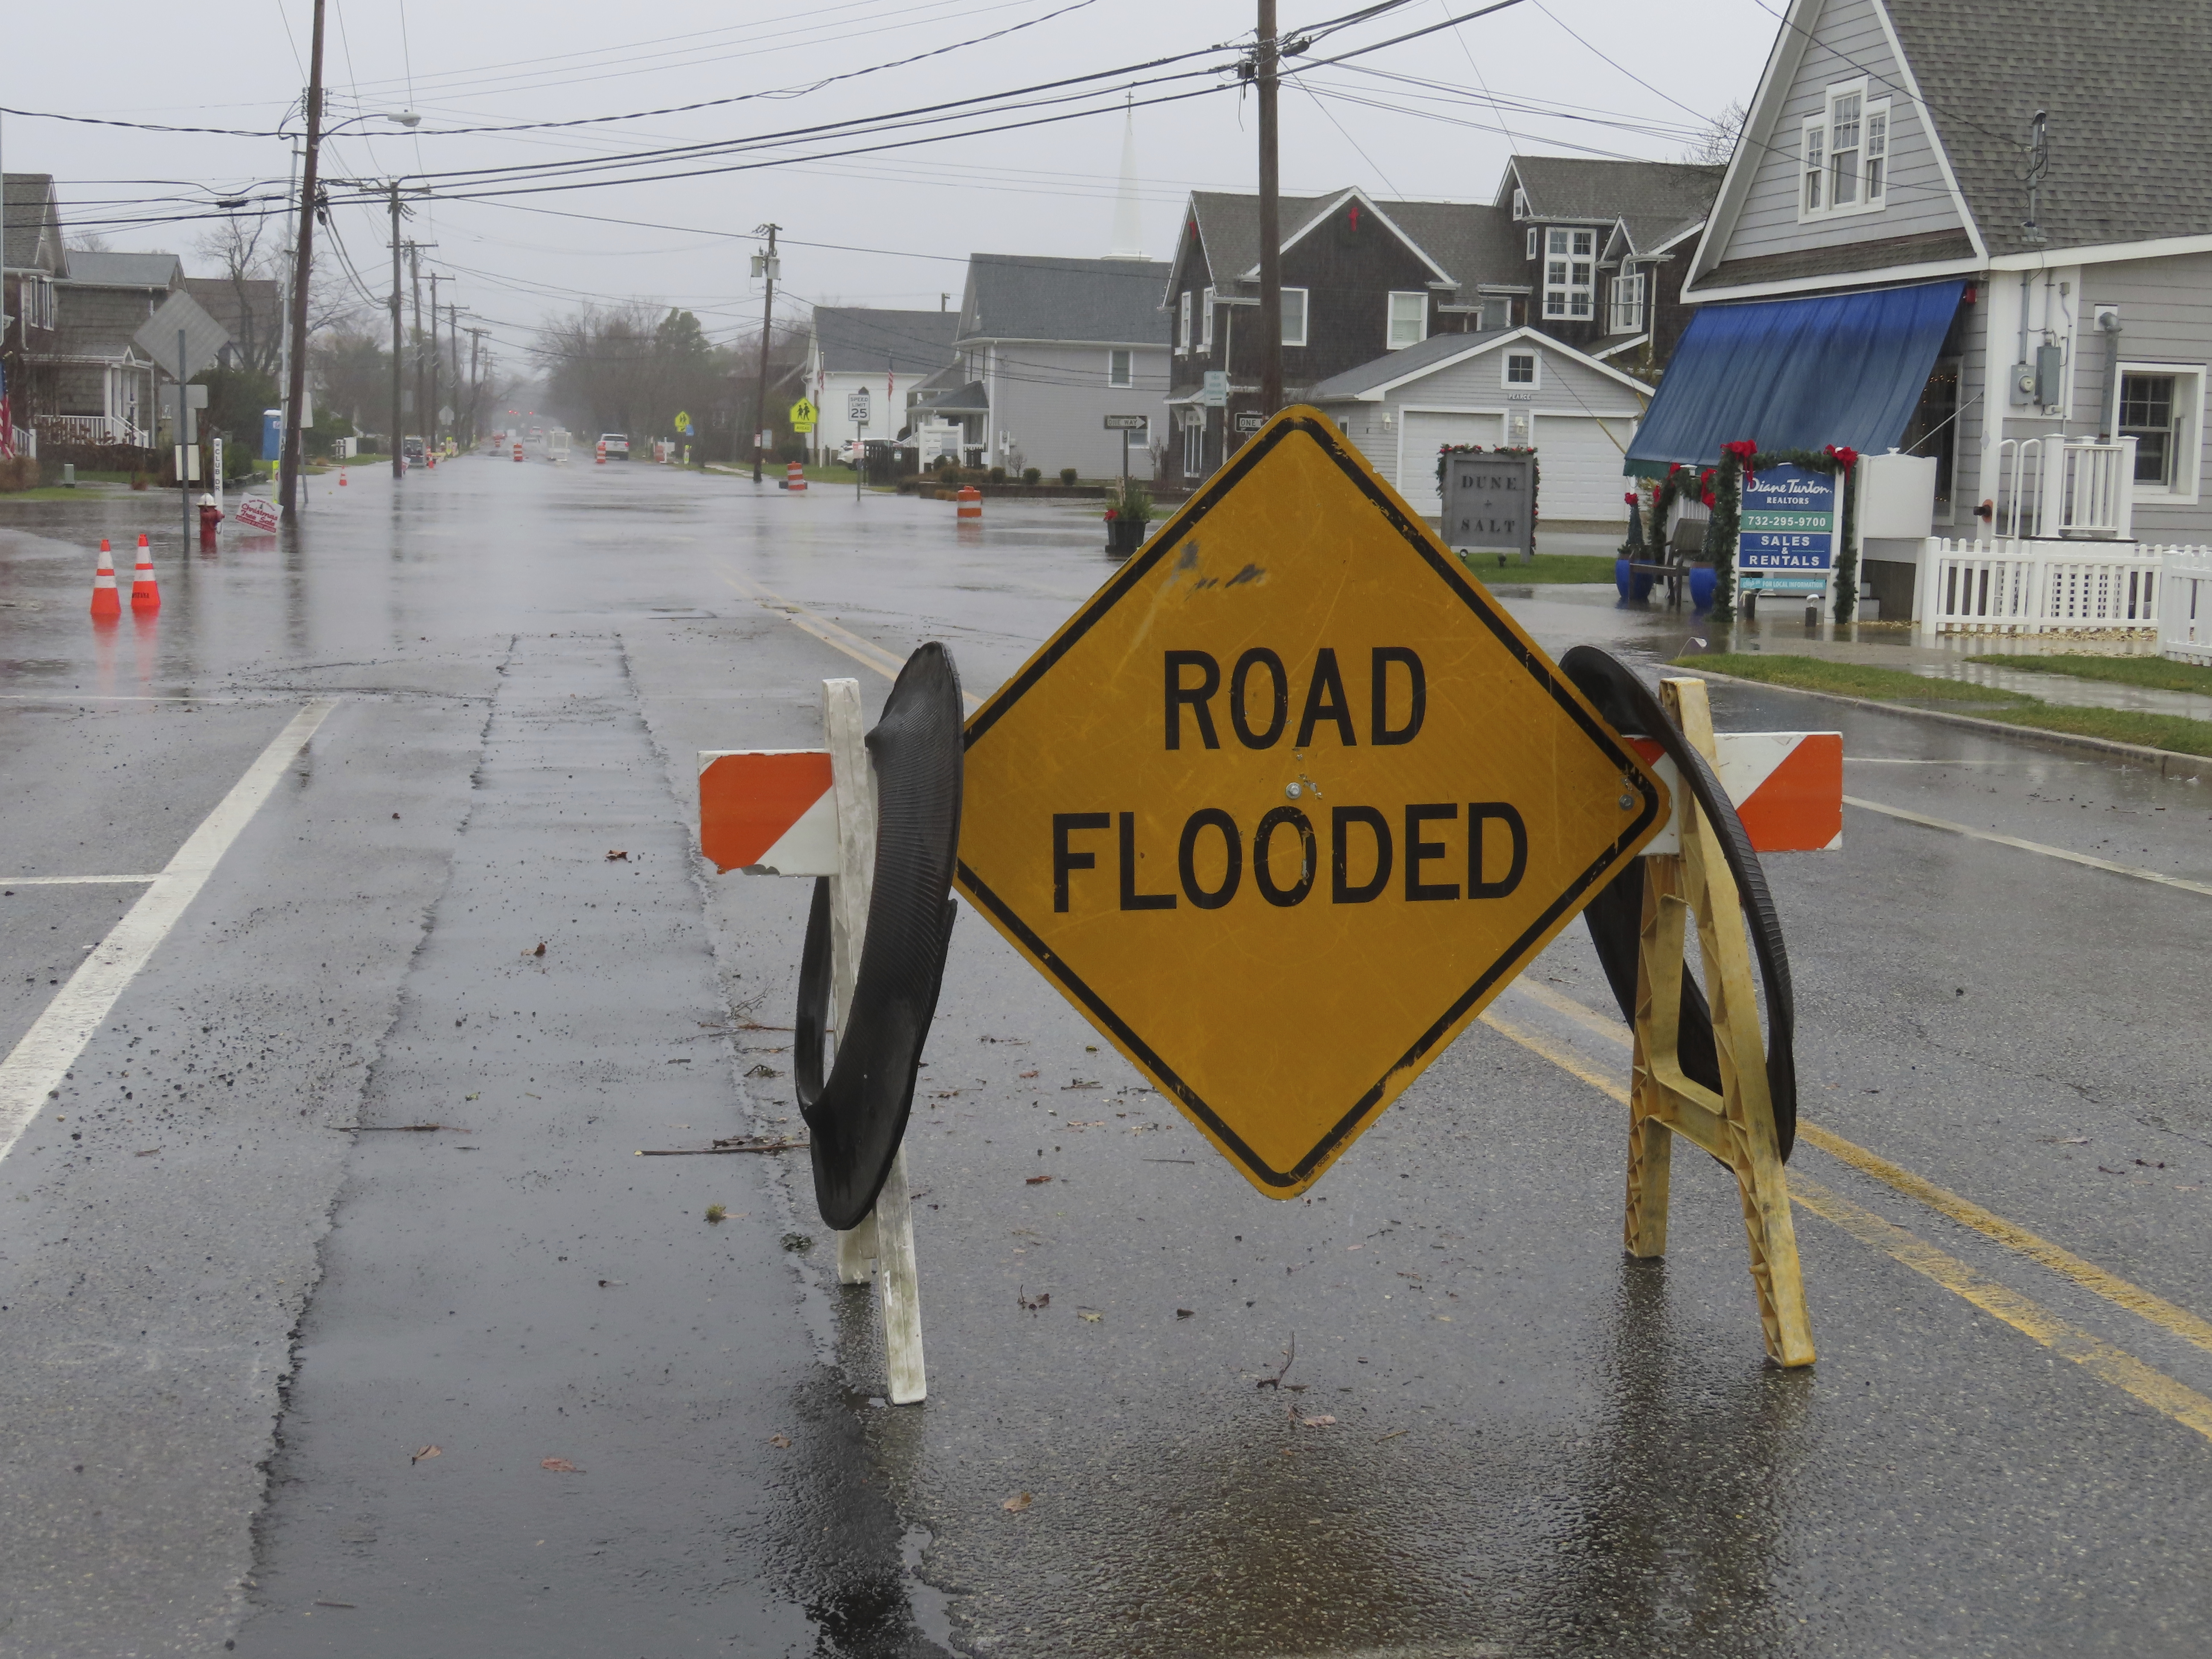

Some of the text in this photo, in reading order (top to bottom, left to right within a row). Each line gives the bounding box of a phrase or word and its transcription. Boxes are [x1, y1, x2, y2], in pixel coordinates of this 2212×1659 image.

[851, 408, 867, 418] 25
[215, 479, 220, 491] DR
[1462, 476, 1517, 490] DUNE
[1746, 477, 1832, 495] Diane Turton
[241, 509, 256, 520] Tree
[259, 517, 275, 527] Sale
[242, 503, 278, 521] Christmas
[1461, 519, 1515, 532] SALT
[1748, 516, 1826, 527] 732-295-9700
[1761, 536, 1810, 547] SALES
[1749, 555, 1819, 566] RENTALS
[1164, 646, 1426, 750] ROAD
[1053, 802, 1528, 913] FLOODED
